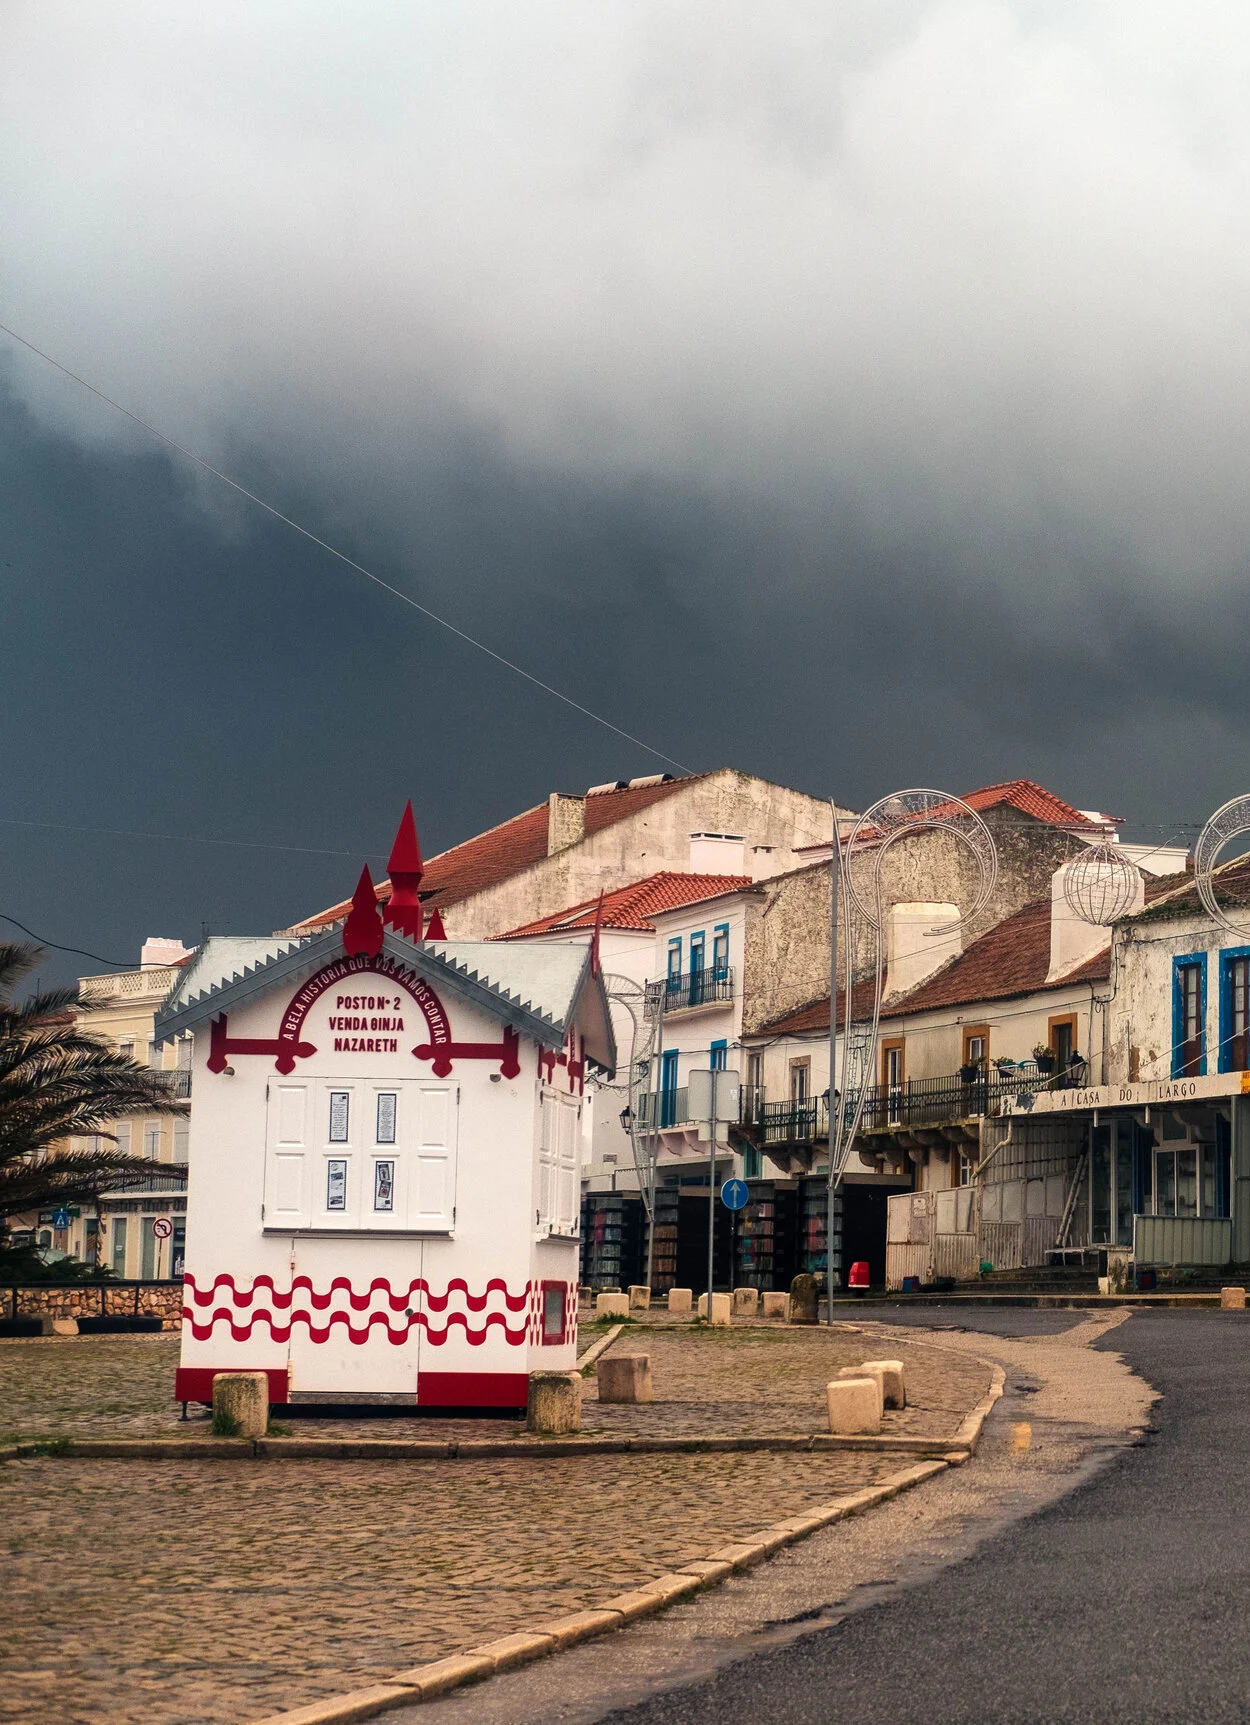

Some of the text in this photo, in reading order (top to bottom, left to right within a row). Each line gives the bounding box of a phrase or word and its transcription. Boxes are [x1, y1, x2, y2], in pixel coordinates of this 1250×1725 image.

[285, 1003, 307, 1031] BELA
[349, 957, 370, 971] QUE
[398, 967, 430, 1002] VAMOS
[424, 1001, 447, 1044] CONTAR
[336, 996, 375, 1010] POSTO
[393, 997, 401, 1010] 2
[329, 1016, 368, 1031] VENDA
[334, 1038, 397, 1052] NAZARETH
[1060, 1082, 1196, 1106] A CASA DO LARGO
